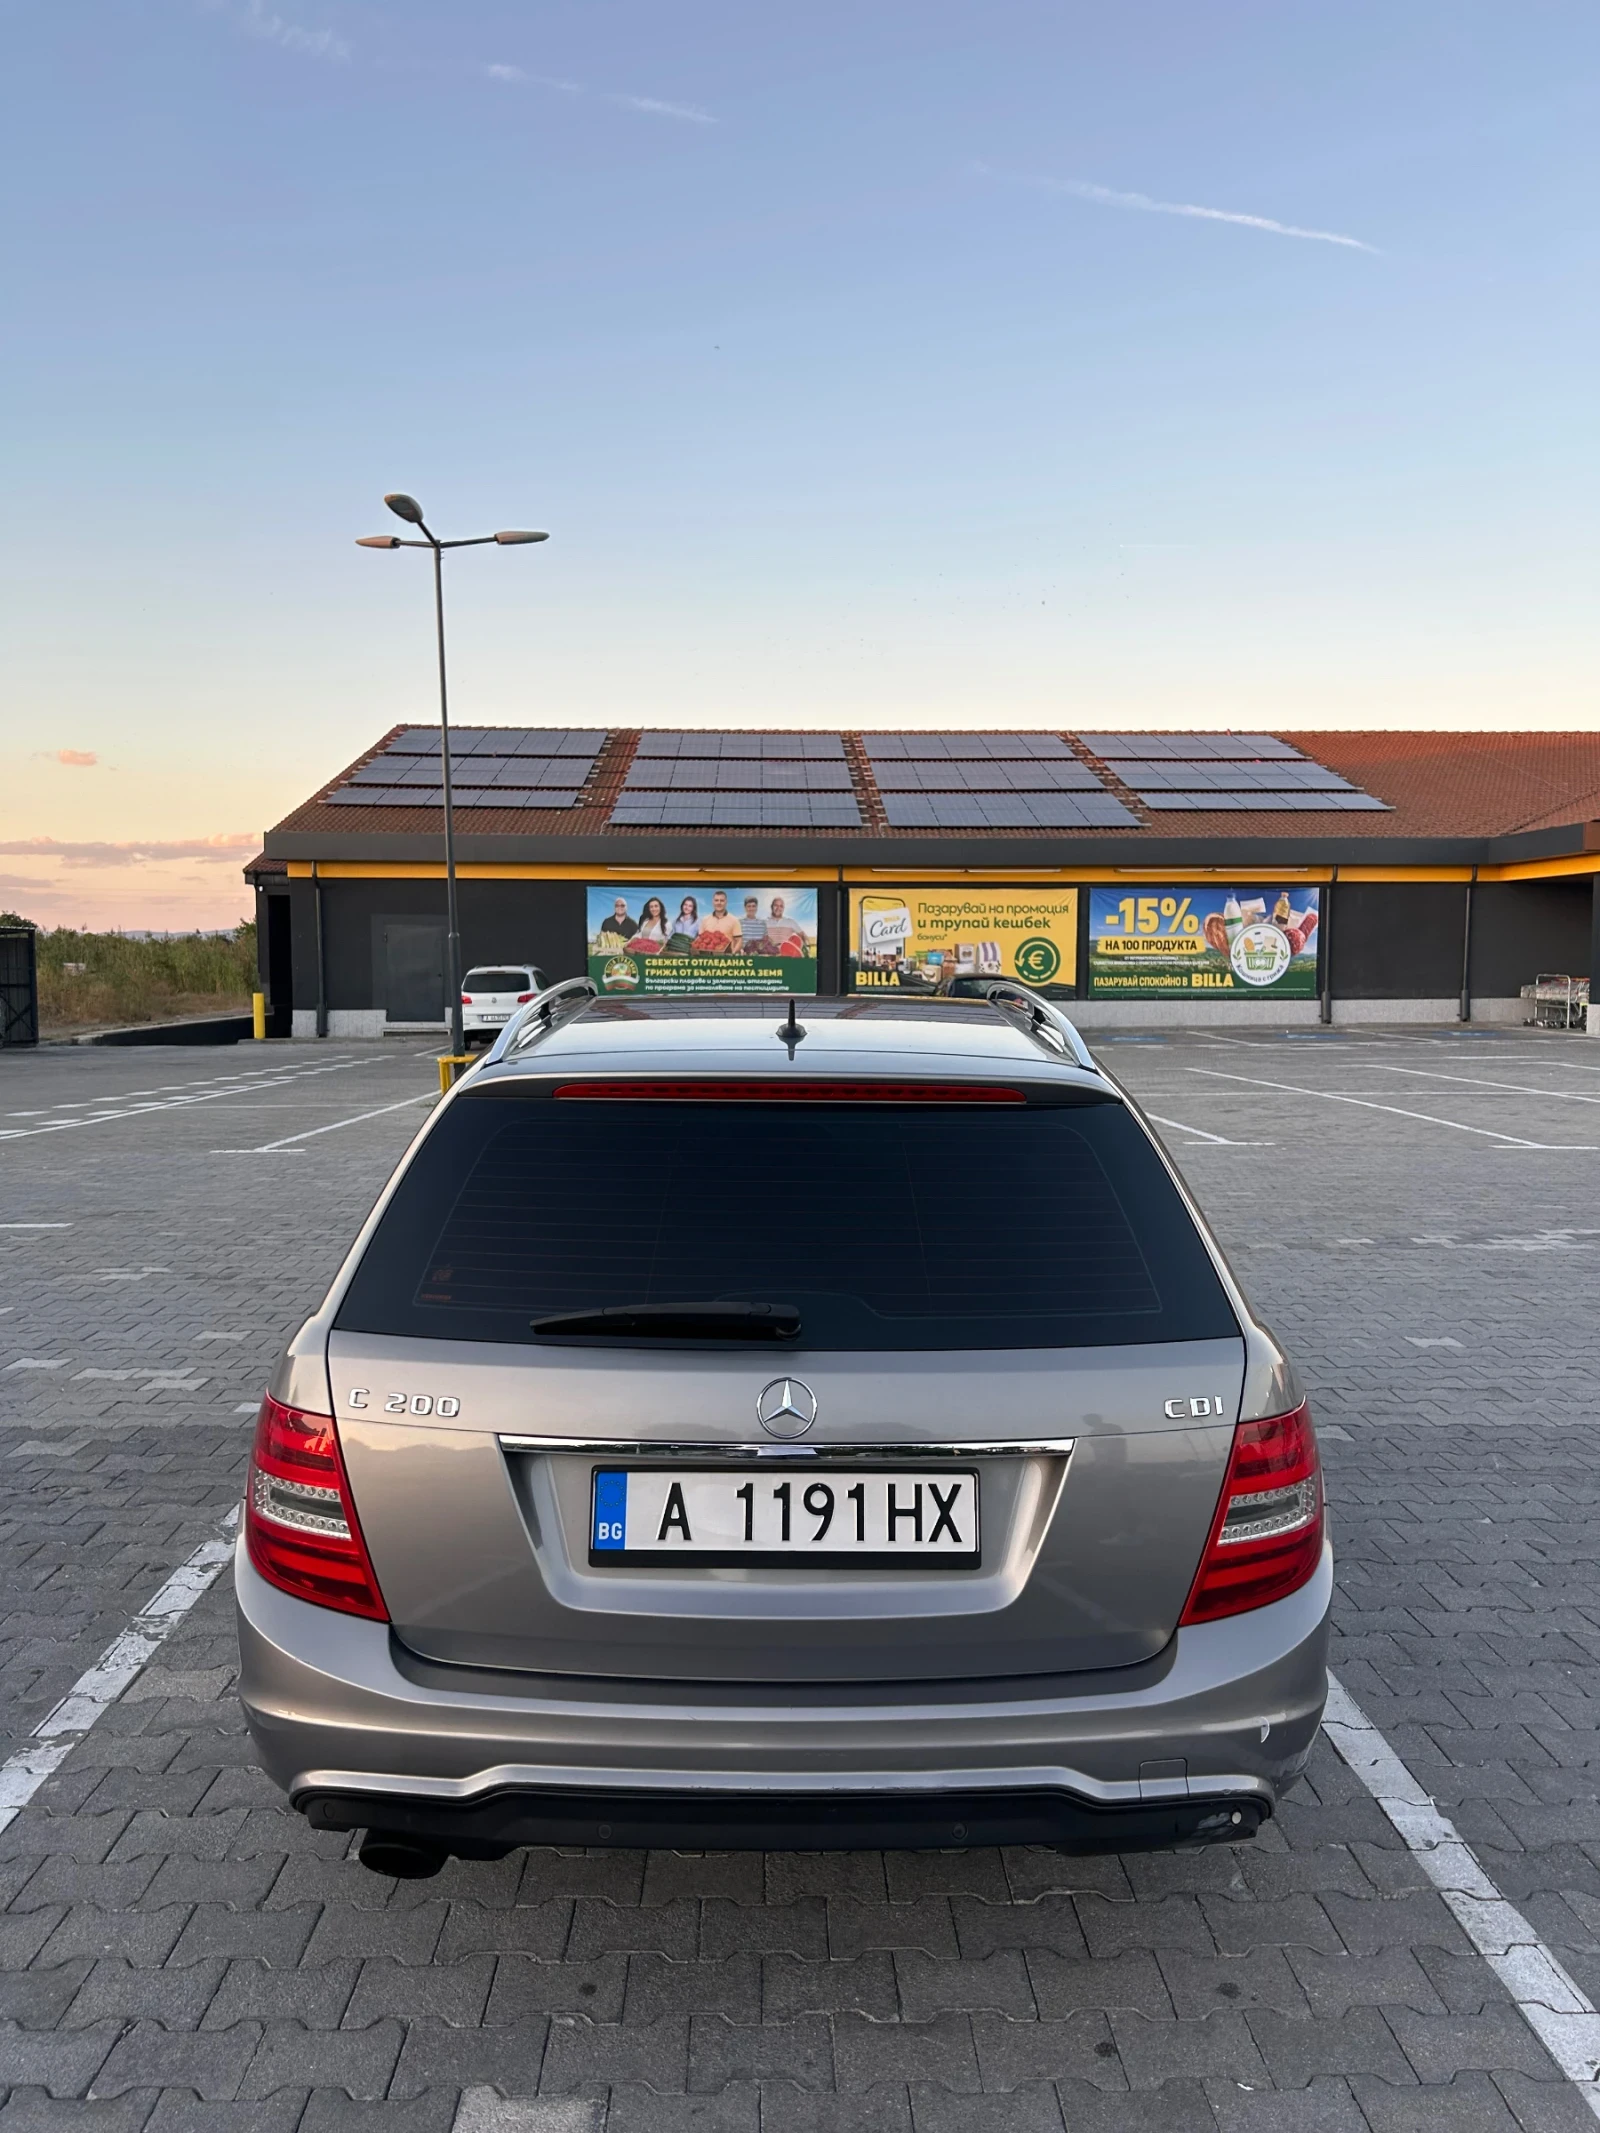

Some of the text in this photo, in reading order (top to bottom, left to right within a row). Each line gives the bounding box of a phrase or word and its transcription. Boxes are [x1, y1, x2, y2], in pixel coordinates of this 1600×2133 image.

[918, 902, 1069, 916] Пазарувай на промоция
[1105, 897, 1199, 934] -15%
[870, 918, 907, 938] Card
[917, 916, 1051, 931] и трупай кешбек
[1105, 940, 1197, 951] НА 100 ПРОДУКТА
[645, 958, 689, 966] СВЕЖЕСТ
[691, 958, 745, 967] ОТГЛЕДАНА
[645, 968, 678, 976] ГРИЖА
[693, 969, 756, 977] БЪЛГАРСКАТА
[757, 969, 783, 977] ЗЕМЯ
[855, 971, 900, 986] BILLA
[1094, 973, 1234, 987] ПАЗАРУВАЙ СПОКОЙНО В BILLA
[348, 1388, 461, 1418] C 200
[1164, 1396, 1224, 1419] CDI
[598, 1522, 623, 1540] BG
[656, 1482, 692, 1541] A
